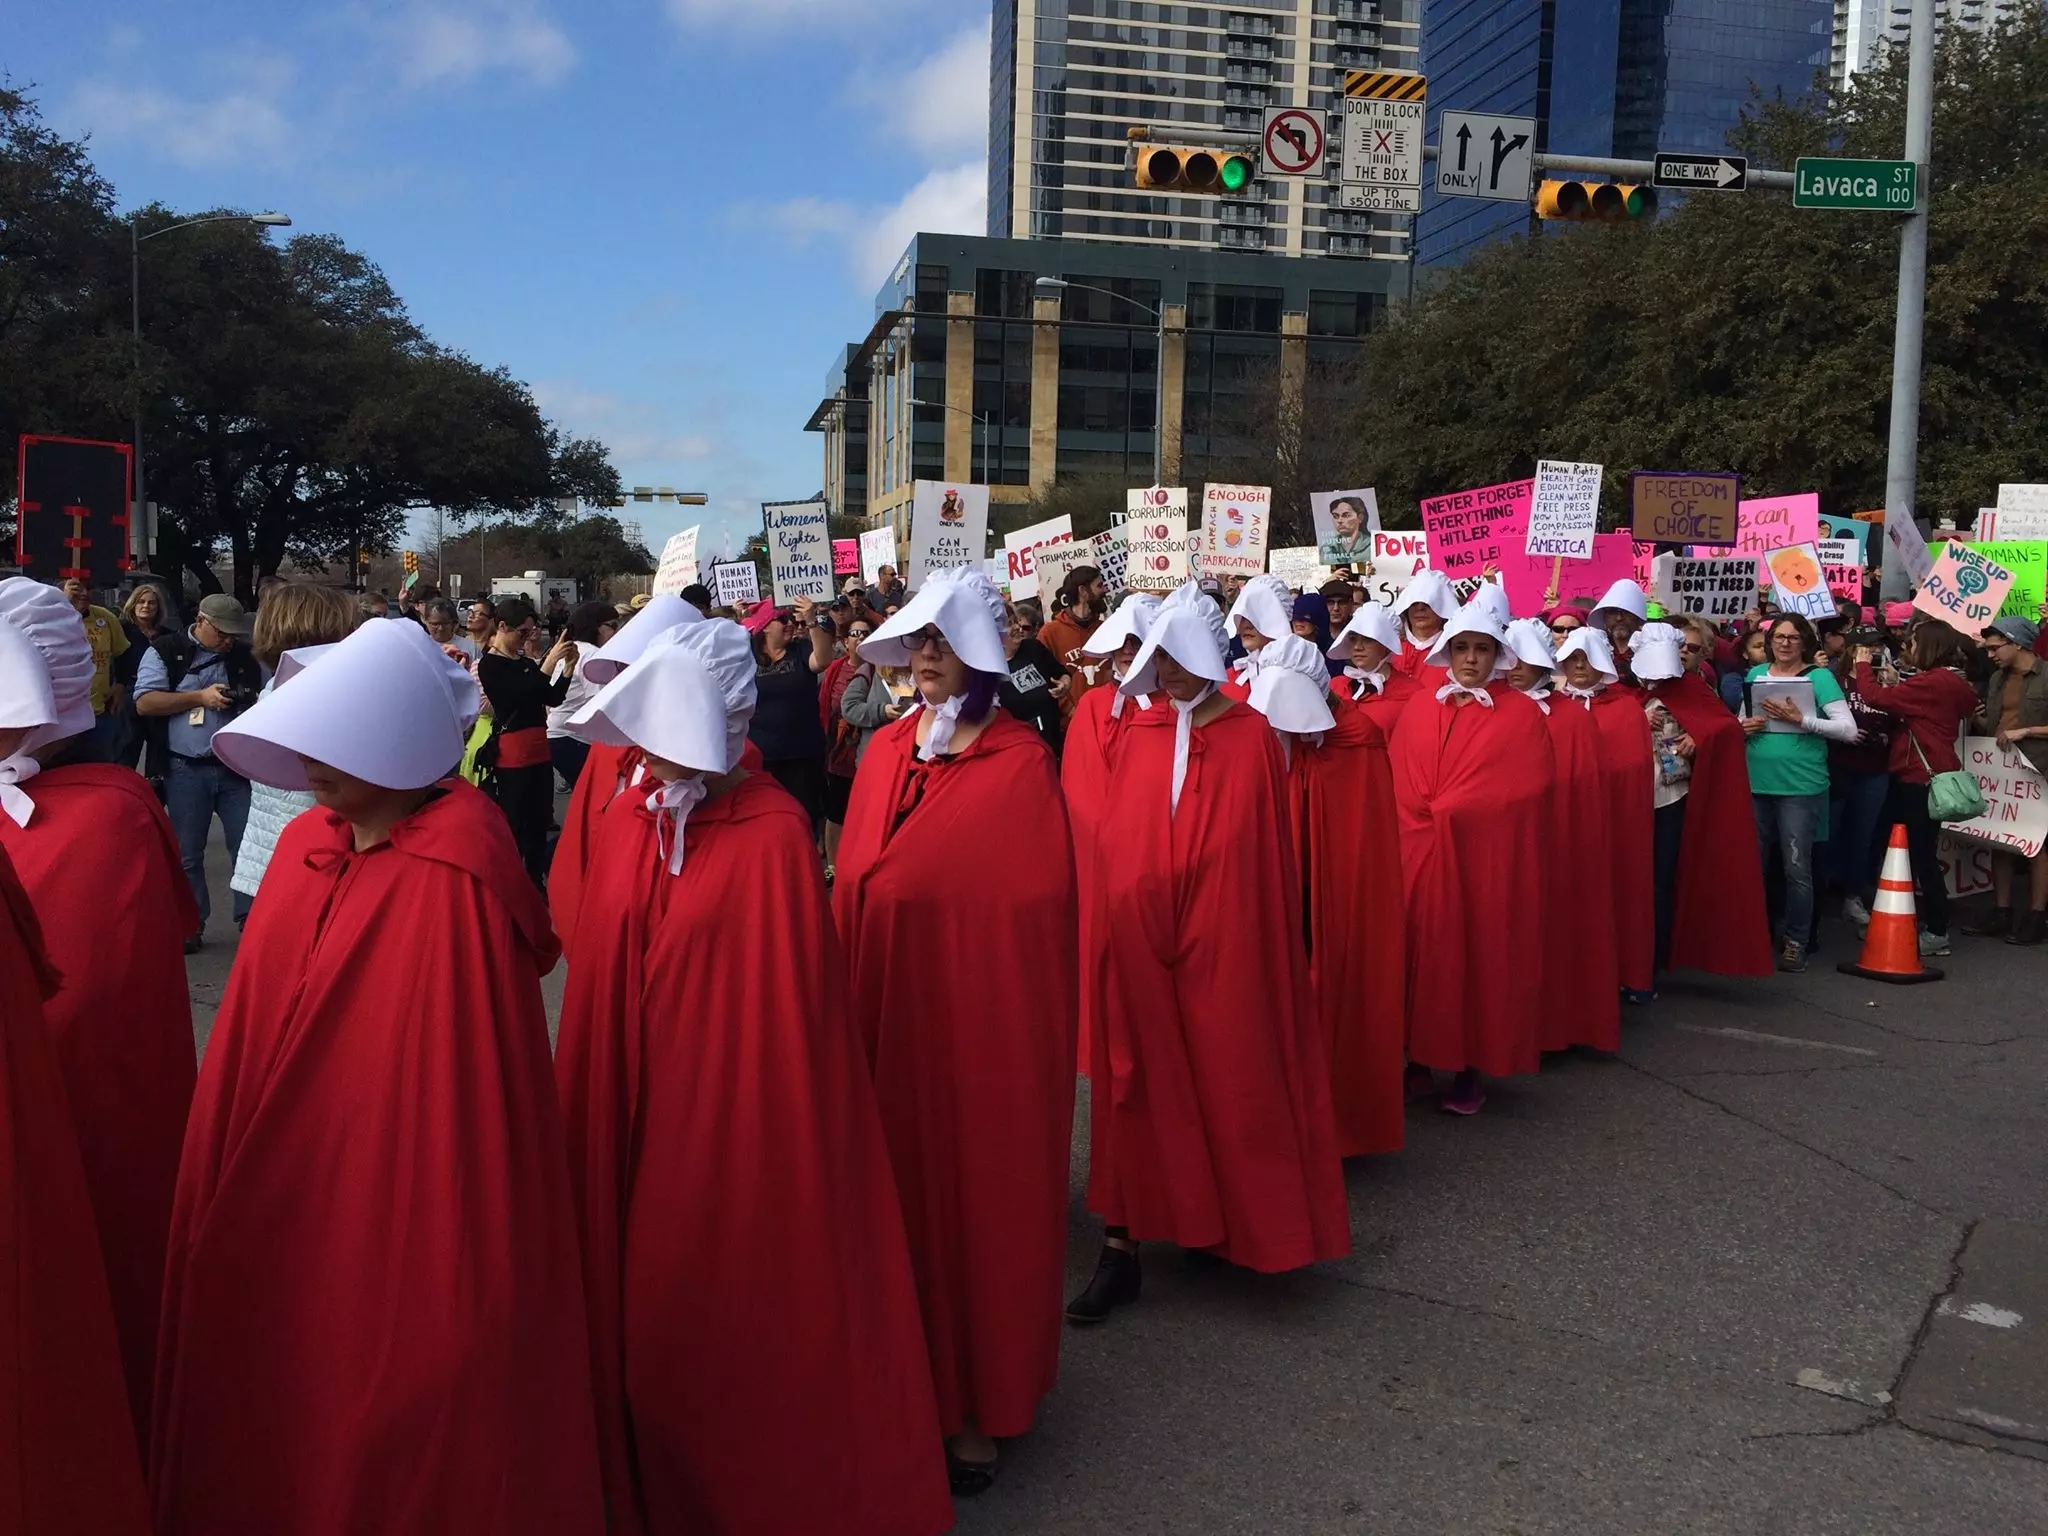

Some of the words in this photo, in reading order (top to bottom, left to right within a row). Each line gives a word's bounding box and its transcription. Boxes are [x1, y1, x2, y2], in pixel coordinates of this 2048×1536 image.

[1384, 104, 1421, 119] BLOCK
[1355, 165, 1378, 180] THE
[1384, 168, 1408, 181] BOX
[1664, 164, 1688, 177] ONE
[1694, 165, 1719, 178] WAY
[1442, 173, 1477, 188] ONLY
[1800, 170, 1877, 197] Lavaca
[1893, 168, 1911, 183] ST
[1362, 188, 1378, 197] UP
[1384, 189, 1399, 198] TO
[1886, 188, 1910, 203] 100
[1350, 197, 1380, 208] $500
[1385, 199, 1411, 210] FINE
[1541, 474, 1574, 482] HEALTH
[1540, 483, 1593, 491] EDUCATION
[1644, 480, 1727, 500] FREEDOM
[1208, 489, 1265, 502] ENOUGH
[1426, 495, 1473, 516] NEVER
[1478, 482, 1534, 505] FORGET
[1538, 492, 1565, 501] CLEAN
[1567, 492, 1593, 501] WATER
[1536, 502, 1559, 512] FREE
[1564, 502, 1590, 512] PRESS
[1671, 500, 1698, 518] OF
[766, 508, 825, 529] Women's
[1428, 503, 1514, 532] EVERYTHING
[1564, 513, 1591, 521] ALWAYS
[1755, 506, 1789, 528] can
[1208, 506, 1217, 552] IMPEACH
[1249, 513, 1261, 545] NOW
[1534, 521, 1593, 531] COMPASSION
[1654, 514, 1723, 539] CHOICE
[779, 531, 821, 552] Rights
[938, 538, 960, 547] CAN
[1439, 525, 1490, 547] HITLER
[929, 547, 969, 557] RESIST
[1374, 533, 1429, 557] POWE
[1528, 536, 1586, 555] AMERICA
[791, 552, 812, 563] are
[1040, 548, 1089, 565] TRUMPCARE
[1203, 554, 1261, 569] FABRICATION
[1444, 551, 1475, 569] WAS
[1949, 543, 1986, 569] WISE
[1986, 562, 2009, 580] UP
[720, 566, 752, 578] HUMANS
[777, 564, 828, 581] HUMAN
[1675, 562, 1719, 577] REAL
[1722, 561, 1755, 575] MEN
[722, 577, 753, 589] AGAINST
[784, 581, 824, 598] RIGHTS
[1672, 578, 1718, 592] DON'T
[1718, 577, 1754, 592] NEED
[723, 590, 735, 601] TED
[736, 588, 755, 599] CRUZ
[1923, 574, 1965, 613] RISE
[1966, 603, 1991, 621] UP
[1683, 596, 1705, 613] TO
[1711, 596, 1748, 615] LIE!
[1783, 591, 1834, 616] NOPE
[1972, 750, 1994, 765] OK
[1978, 775, 1999, 793] OW
[2004, 779, 2041, 800] LET'S
[2001, 802, 2019, 821] IN
